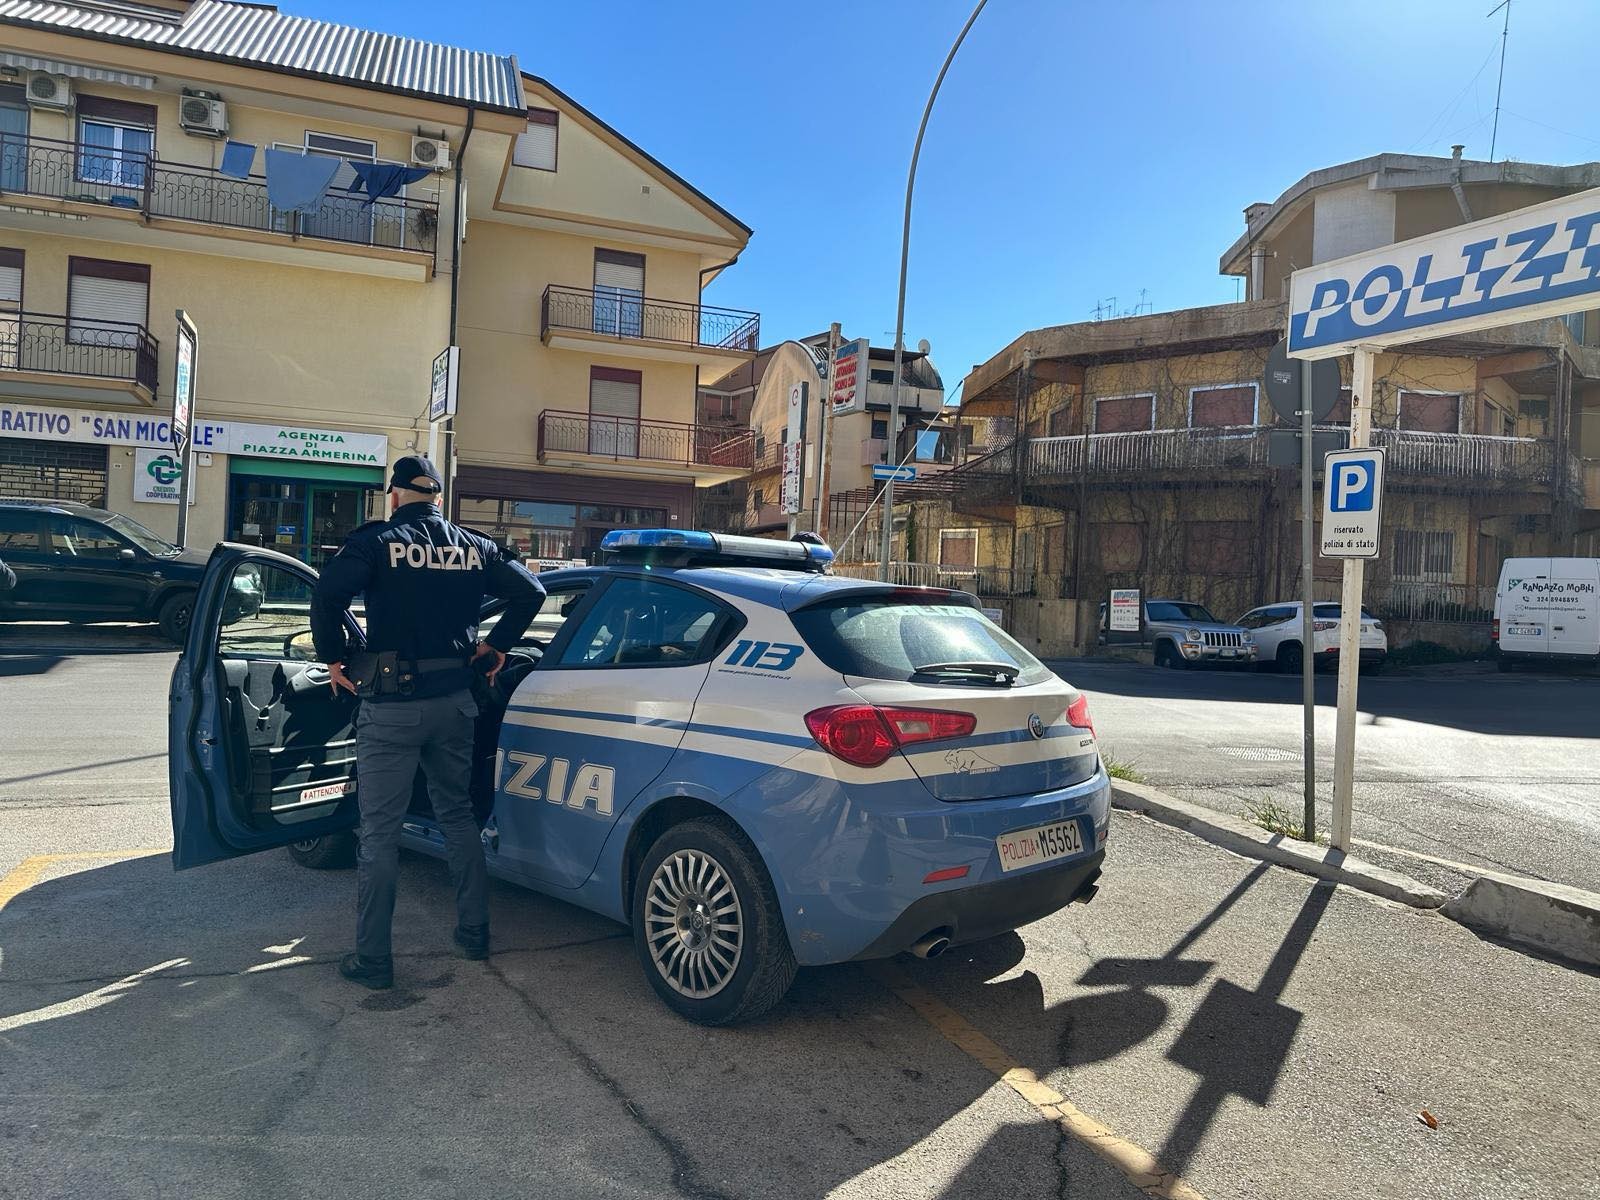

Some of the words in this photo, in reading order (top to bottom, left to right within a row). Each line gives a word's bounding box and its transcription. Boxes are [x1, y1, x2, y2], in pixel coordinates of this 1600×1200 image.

[1303, 211, 1600, 338] POLIZI
[1, 410, 71, 434] RATIVO
[278, 431, 345, 443] AGENZIA
[243, 444, 298, 456] PIAZZA
[301, 449, 377, 462] ARMERINA
[1338, 465, 1368, 508] P
[389, 542, 483, 570] POLIZIA
[1324, 540, 1344, 549] polizia
[1346, 540, 1353, 548] di
[1356, 540, 1374, 548] stato
[1522, 583, 1564, 592] RANDAZZO
[1566, 583, 1594, 593] MOBILI
[724, 640, 805, 671] 113
[308, 784, 349, 799] ATTENZIONE
[1002, 839, 1036, 861] POLIZIA
[1038, 824, 1080, 858] M5562
